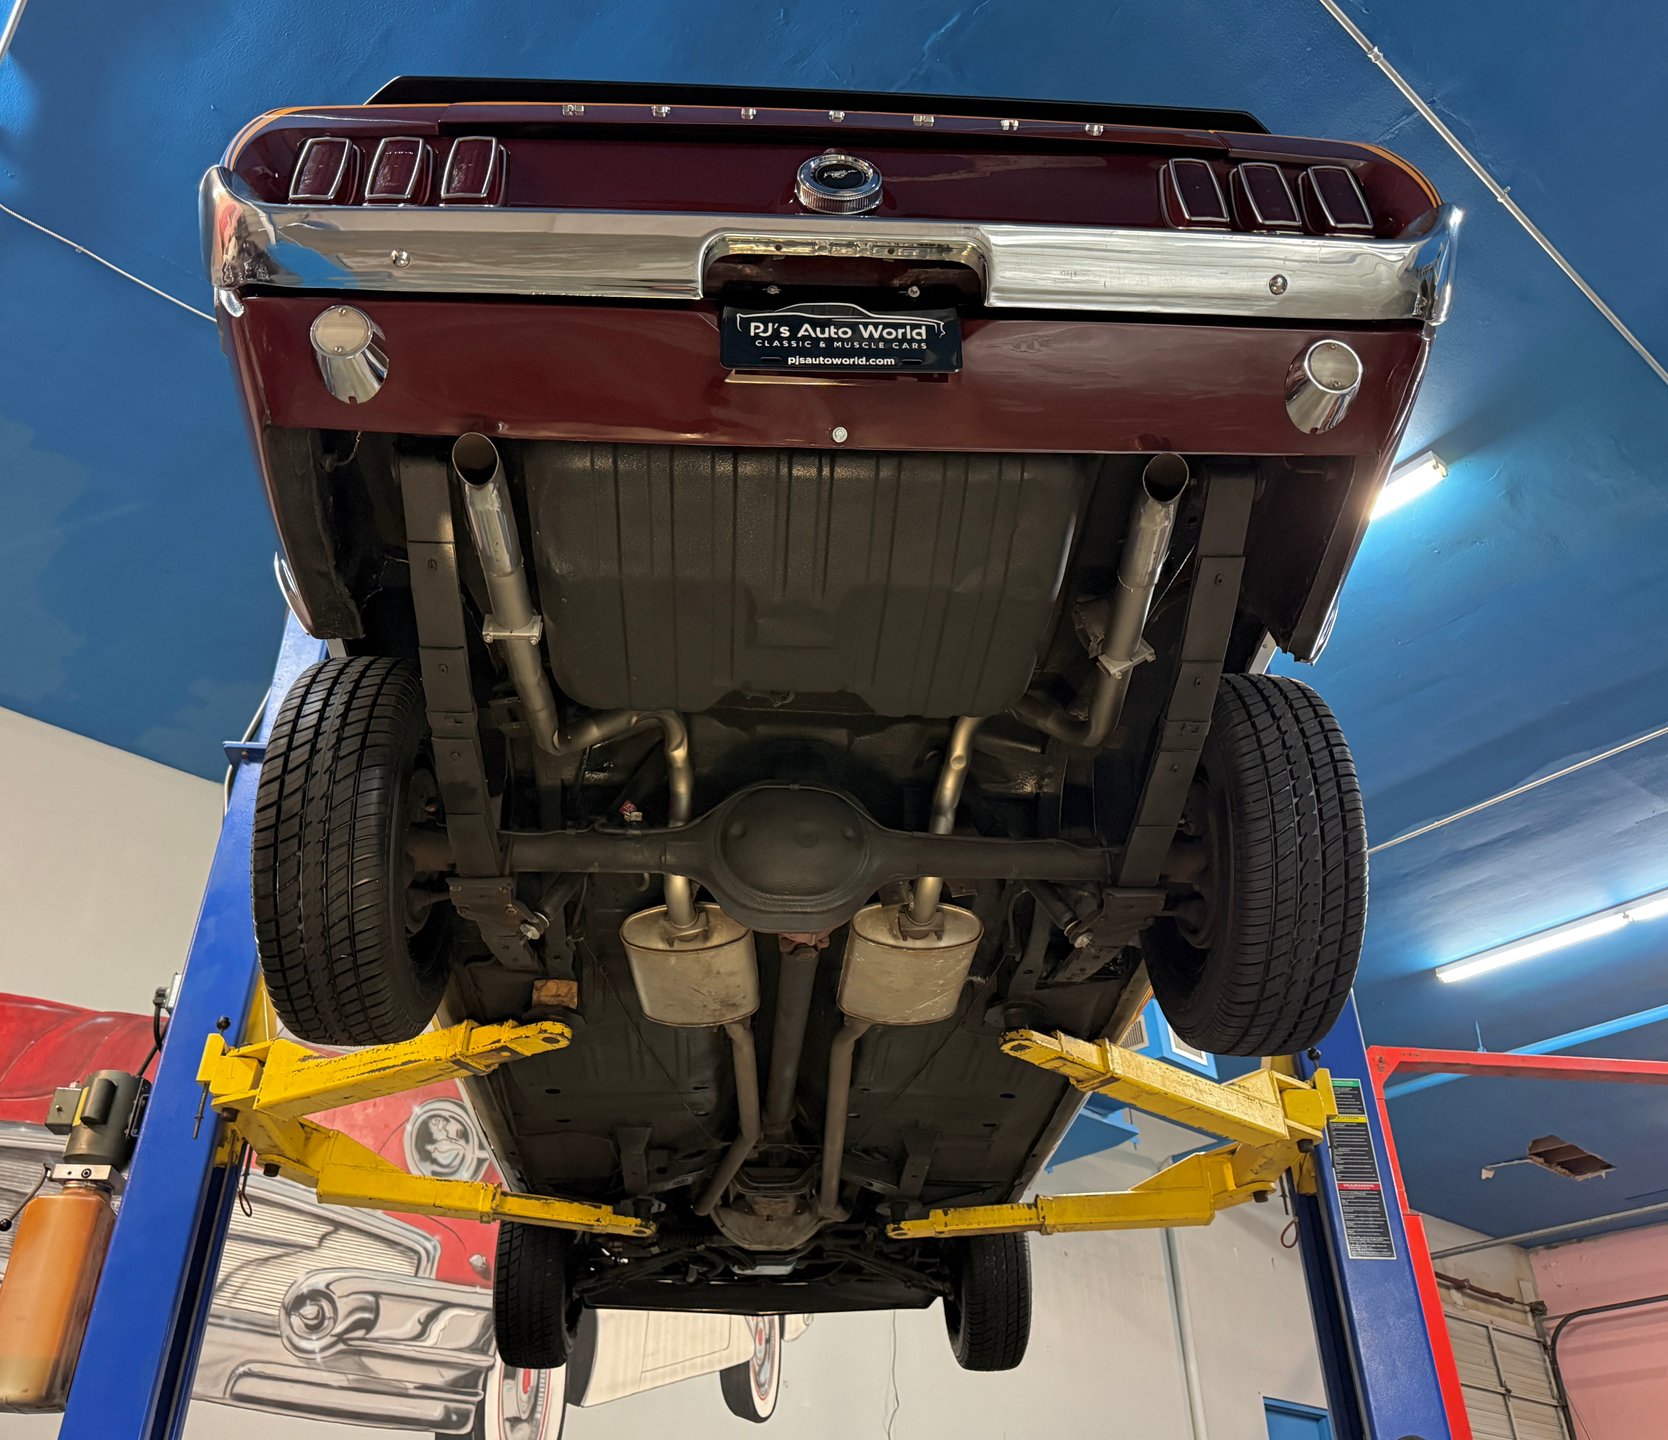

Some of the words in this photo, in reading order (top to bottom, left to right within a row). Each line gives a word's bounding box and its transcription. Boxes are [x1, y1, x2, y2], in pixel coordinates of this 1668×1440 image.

[750, 322, 790, 338] PJ's
[798, 323, 852, 339] Auto
[859, 325, 926, 340] World
[755, 339, 812, 348] CLASSIC
[833, 341, 885, 349] MUSCLE
[892, 342, 928, 350] CARS
[787, 356, 895, 366] pjsautoworld.com
